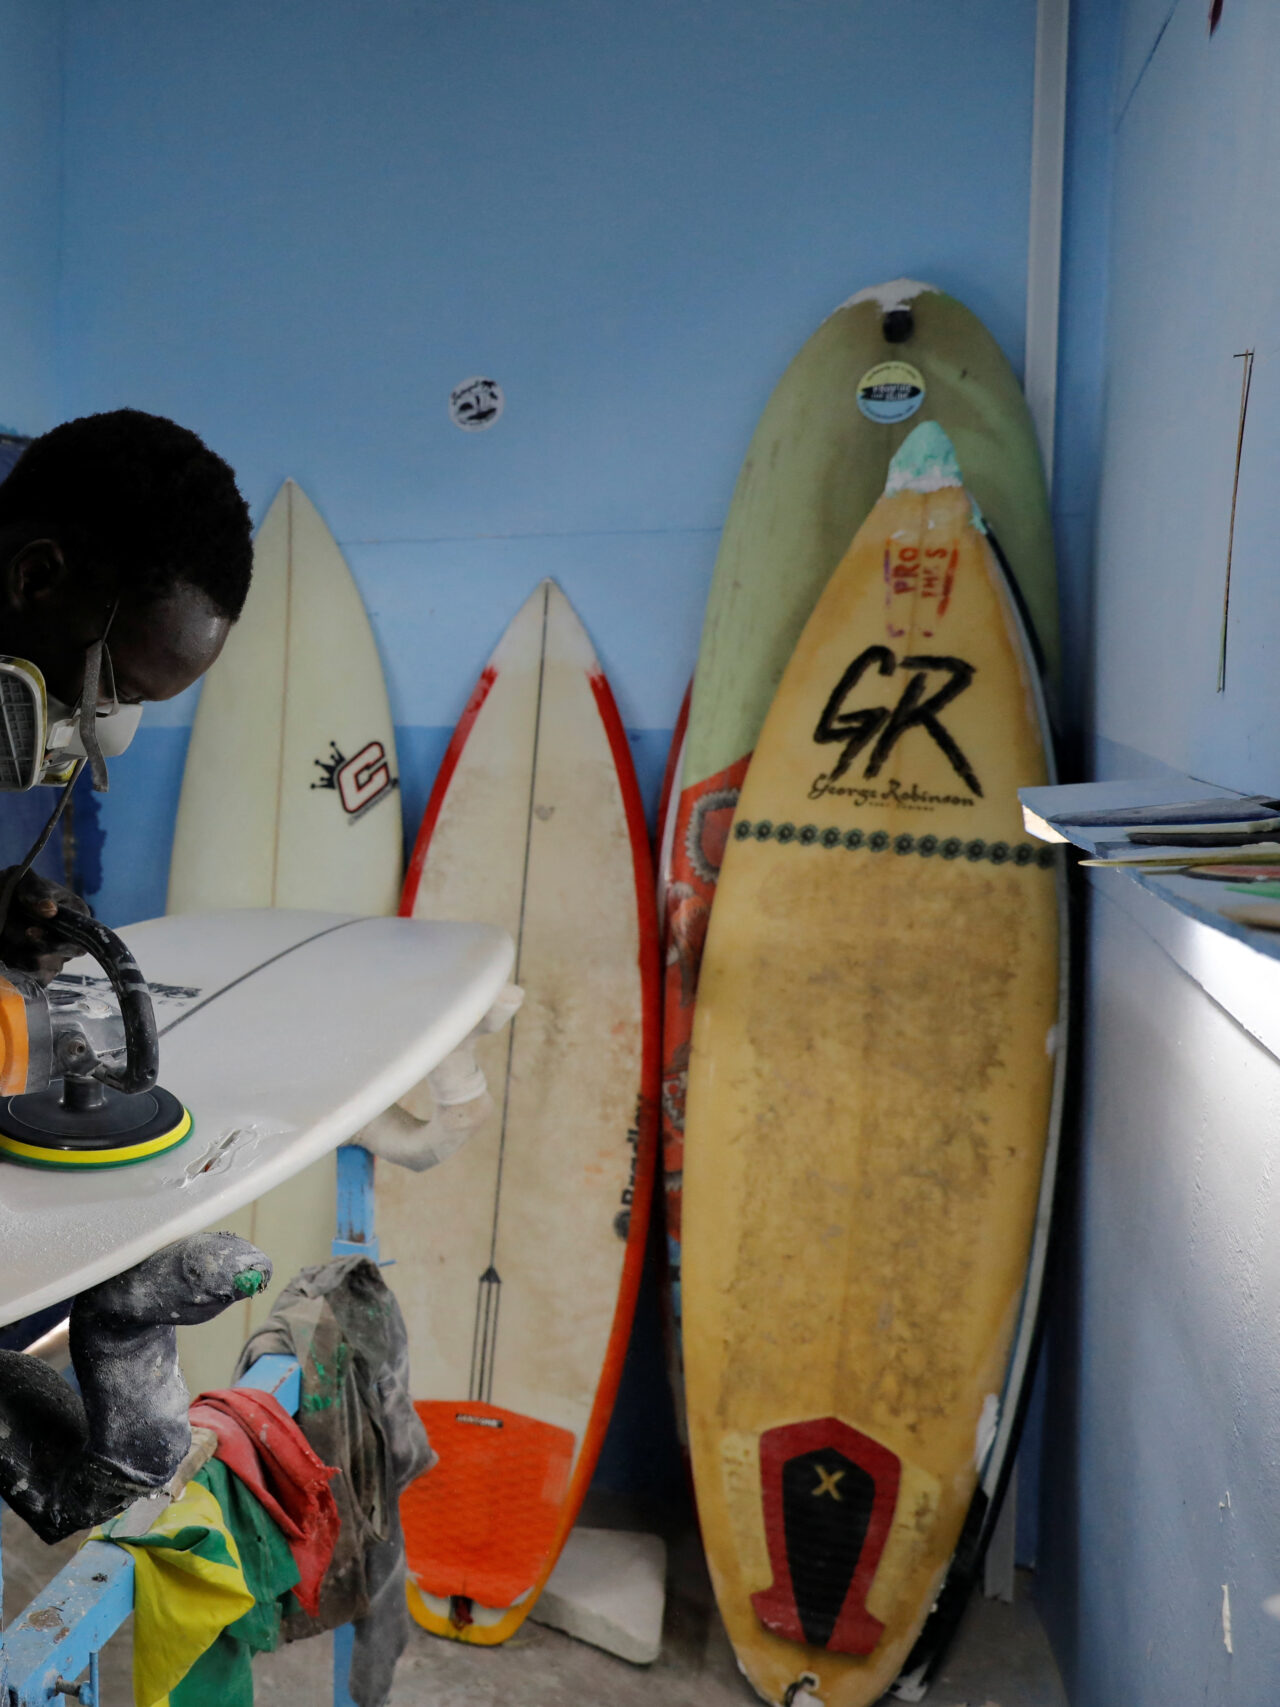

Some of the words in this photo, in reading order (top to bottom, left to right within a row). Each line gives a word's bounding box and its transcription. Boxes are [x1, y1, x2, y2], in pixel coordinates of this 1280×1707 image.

[892, 547, 920, 595] PRO
[813, 645, 984, 798] GR
[807, 774, 877, 807] George
[881, 779, 975, 807] Robinson
